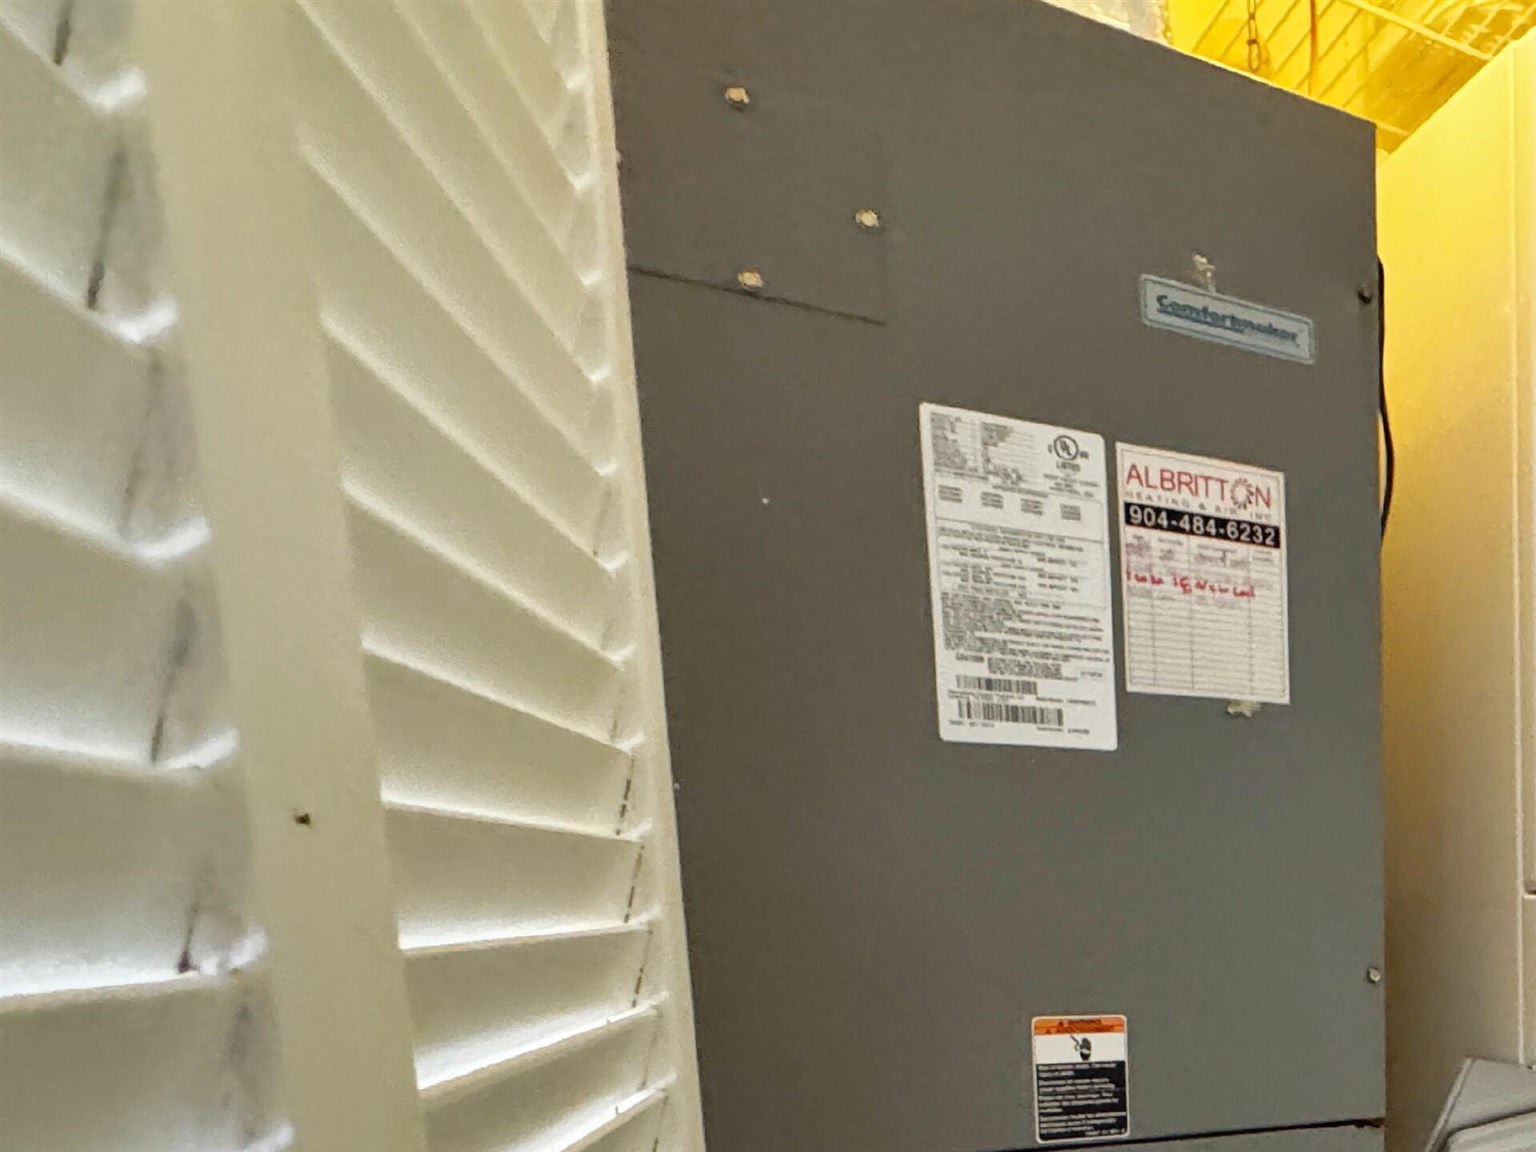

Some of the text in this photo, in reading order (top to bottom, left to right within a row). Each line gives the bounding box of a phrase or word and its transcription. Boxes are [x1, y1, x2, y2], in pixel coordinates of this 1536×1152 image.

[1125, 491, 1191, 509] HEATING
[1126, 463, 1272, 510] ALBRITTON
[1129, 505, 1275, 546] 904-484-6232
